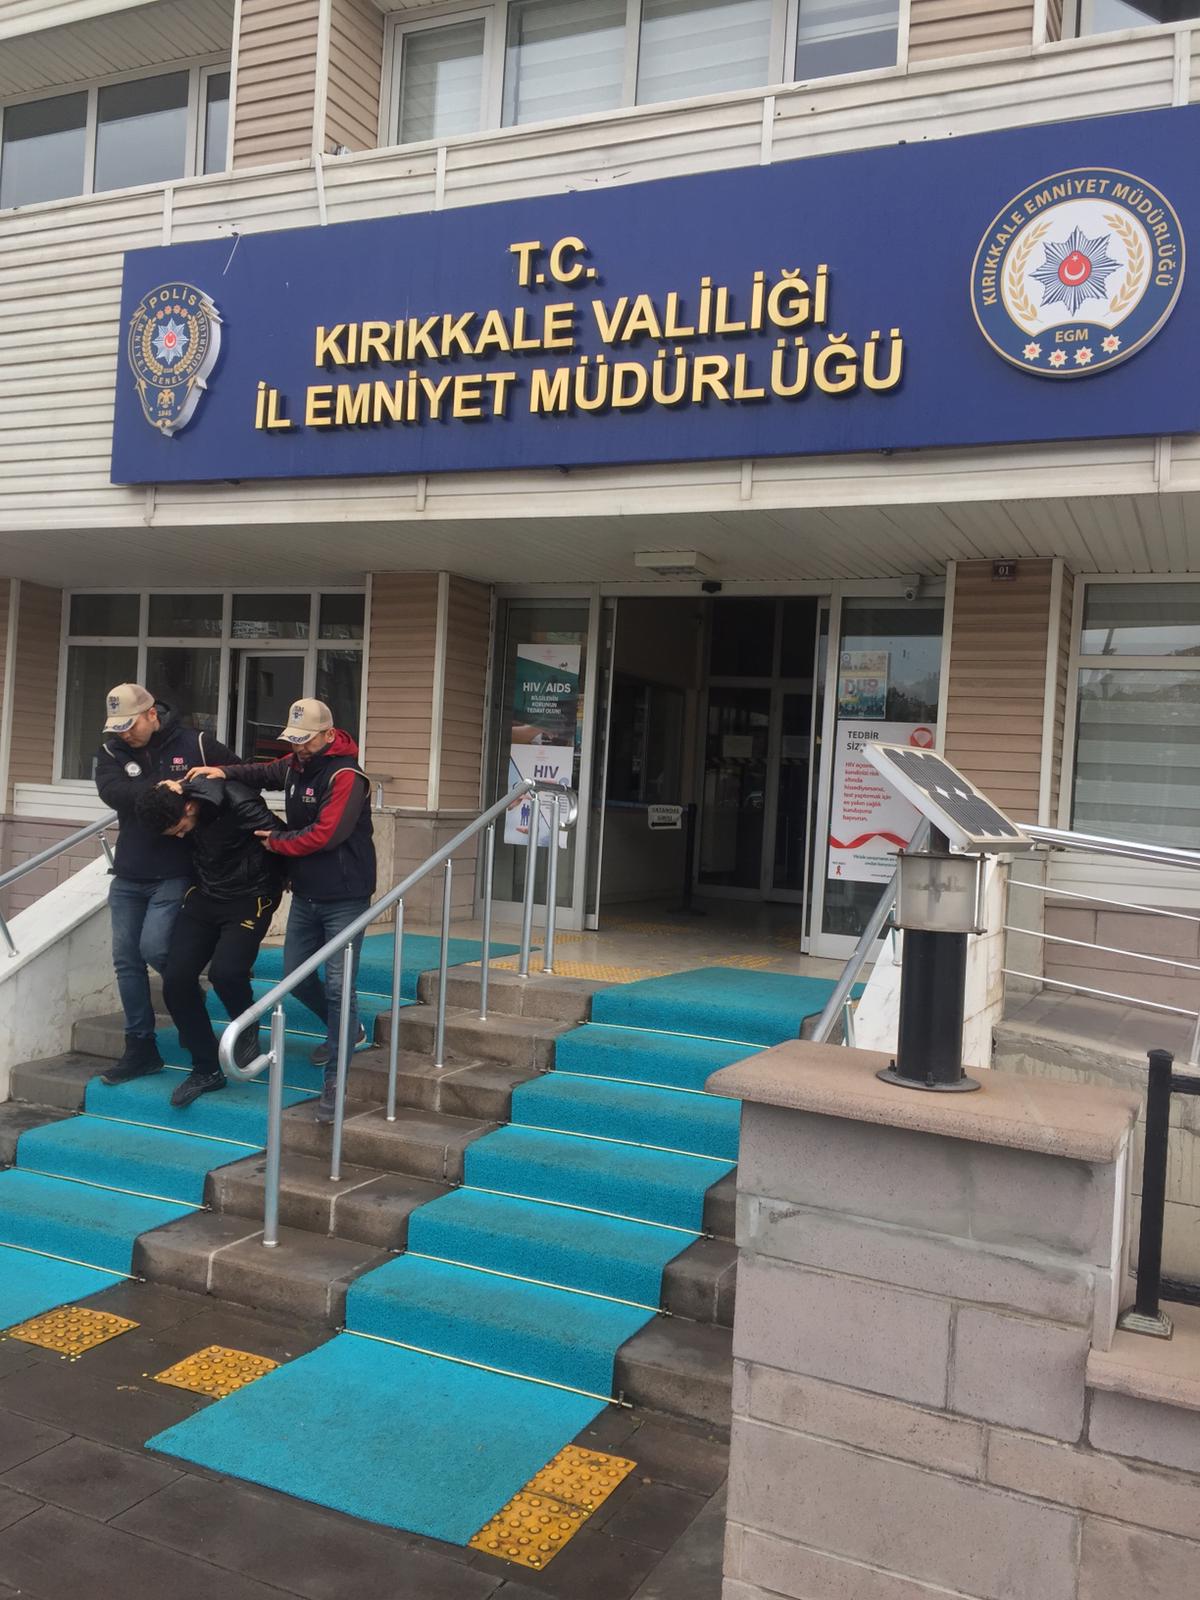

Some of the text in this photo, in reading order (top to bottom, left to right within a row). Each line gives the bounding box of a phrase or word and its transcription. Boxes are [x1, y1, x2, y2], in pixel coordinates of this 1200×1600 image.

[982, 179, 1177, 306] KIRIKKALE EMNİYET MÜDÜRLÜĞÜ
[510, 236, 597, 287] T.C.
[149, 287, 197, 309] POLİS
[315, 264, 829, 368] KIRIKKALE VALİLİĞİ
[1055, 328, 1089, 343] EGM
[152, 374, 182, 385] GENEL
[255, 328, 904, 429] İL EMNİYET MÜDÜRLÜĞÜ
[523, 681, 572, 694] HIV/AIDS
[847, 730, 880, 740] TEDBİR
[533, 764, 560, 779] HIV
